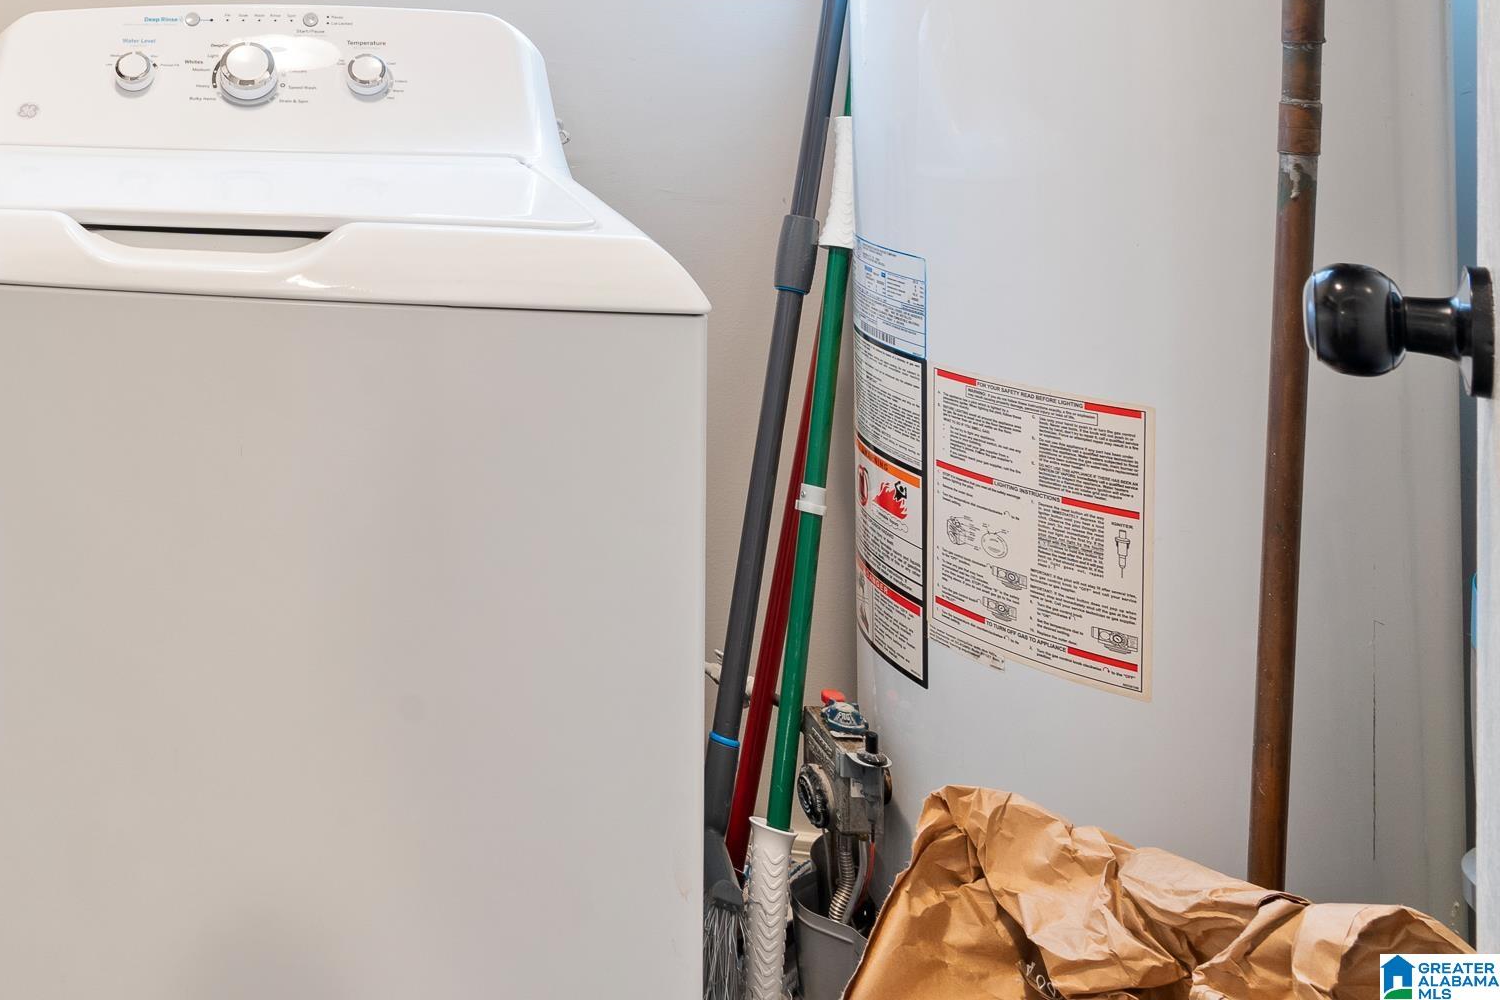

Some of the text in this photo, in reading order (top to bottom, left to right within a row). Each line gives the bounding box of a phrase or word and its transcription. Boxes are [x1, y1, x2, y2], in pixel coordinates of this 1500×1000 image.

[987, 384, 1001, 392] YOUR
[1001, 387, 1020, 396] SAFETY
[1020, 391, 1035, 399] READ
[1035, 394, 1057, 404] BEFORE
[1057, 399, 1083, 408] LIGHTING
[994, 481, 1060, 502] LIGHTING INSTRUCTIONS
[1111, 521, 1133, 529] IGNITER
[993, 623, 1006, 632] TURN
[1006, 628, 1017, 636] OFF
[1017, 632, 1028, 640] GAS
[1037, 640, 1067, 653] APPLIANCE
